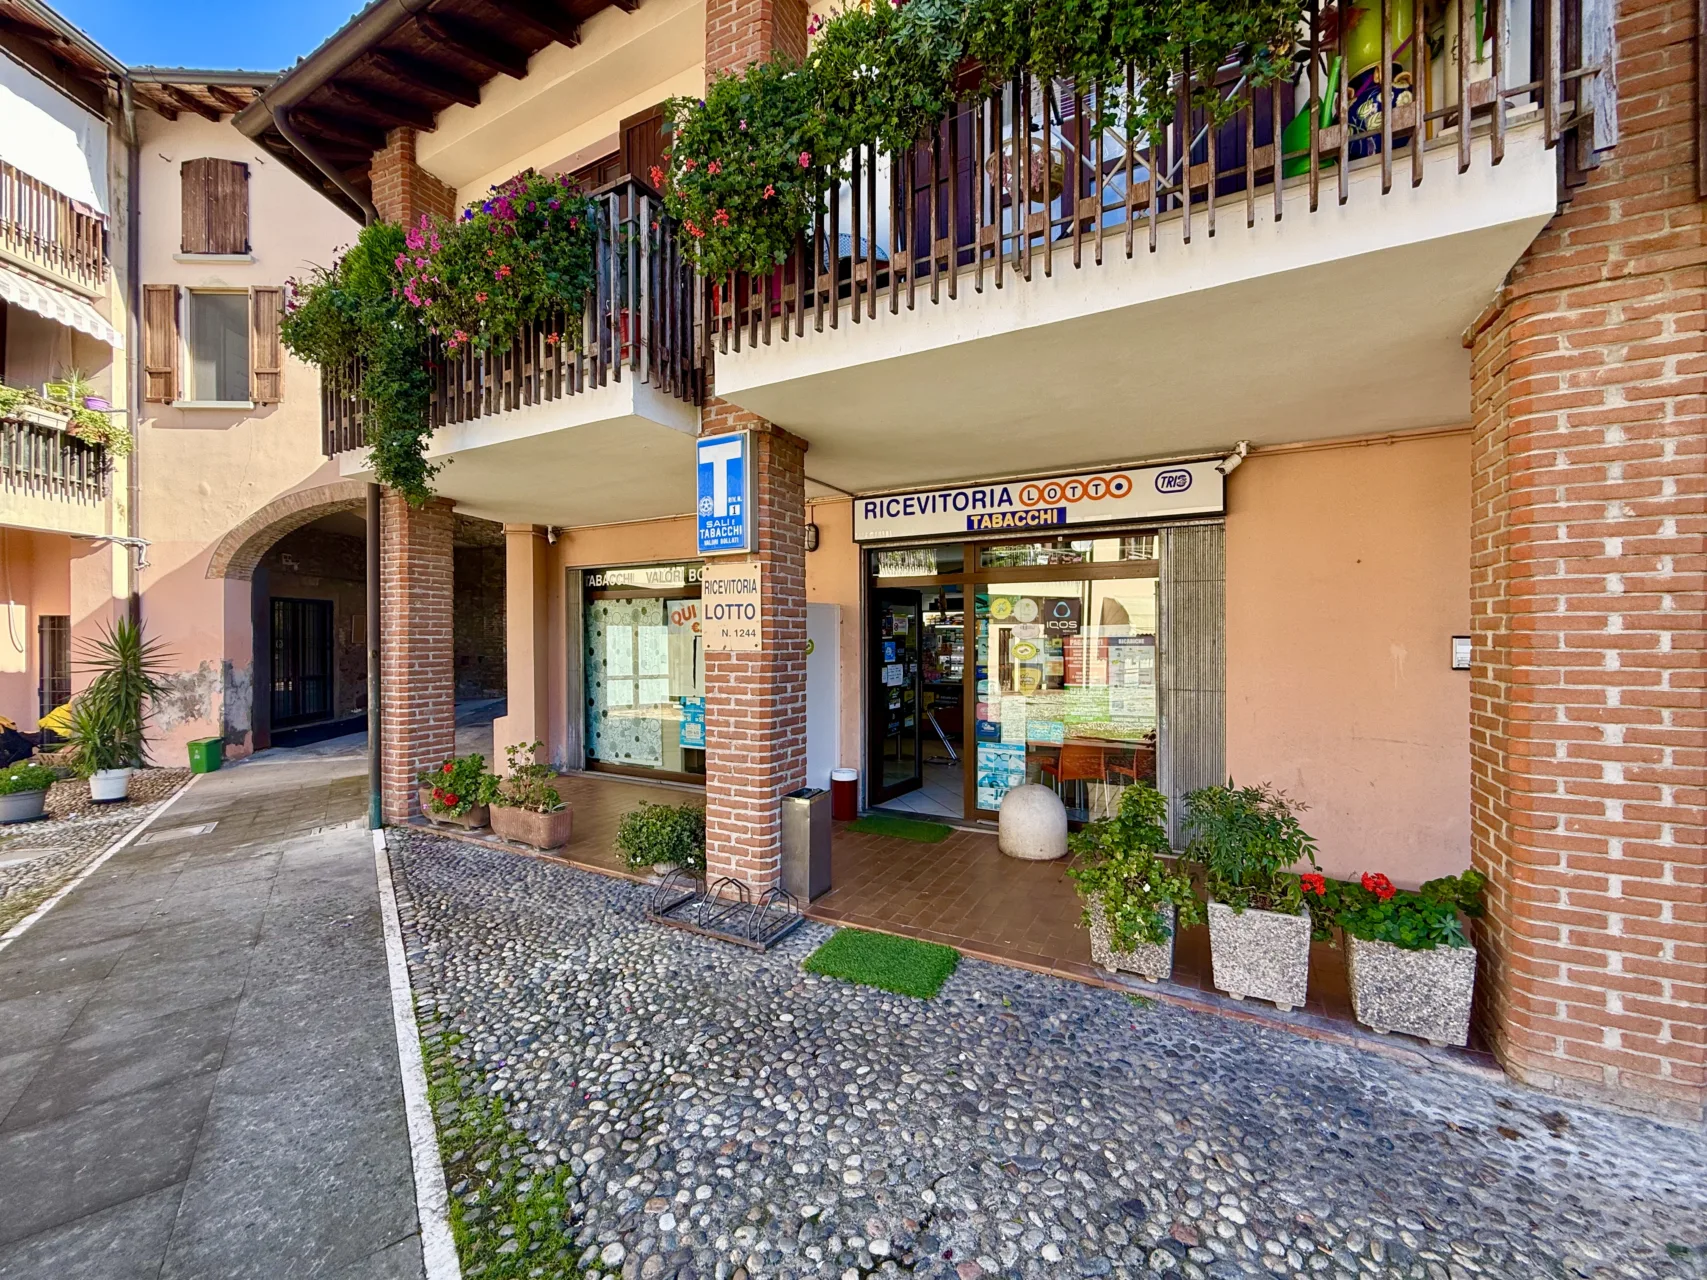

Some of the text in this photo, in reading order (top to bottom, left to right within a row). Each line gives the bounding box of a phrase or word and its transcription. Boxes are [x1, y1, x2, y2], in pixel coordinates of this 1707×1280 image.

[699, 440, 742, 517] T
[865, 474, 1132, 520] RICEVITORIA LOTTO
[706, 518, 730, 528] SALI
[970, 507, 1058, 530] TABACCHI
[700, 525, 743, 540] TABACCHI
[586, 571, 634, 588] TABACCHI
[645, 567, 684, 585] VALORI
[704, 578, 758, 596] RICEVITORIA
[671, 604, 697, 627] QUI
[705, 603, 756, 621] LOTTO
[721, 628, 757, 638] N. 1244
[1046, 620, 1078, 630] IQOS
